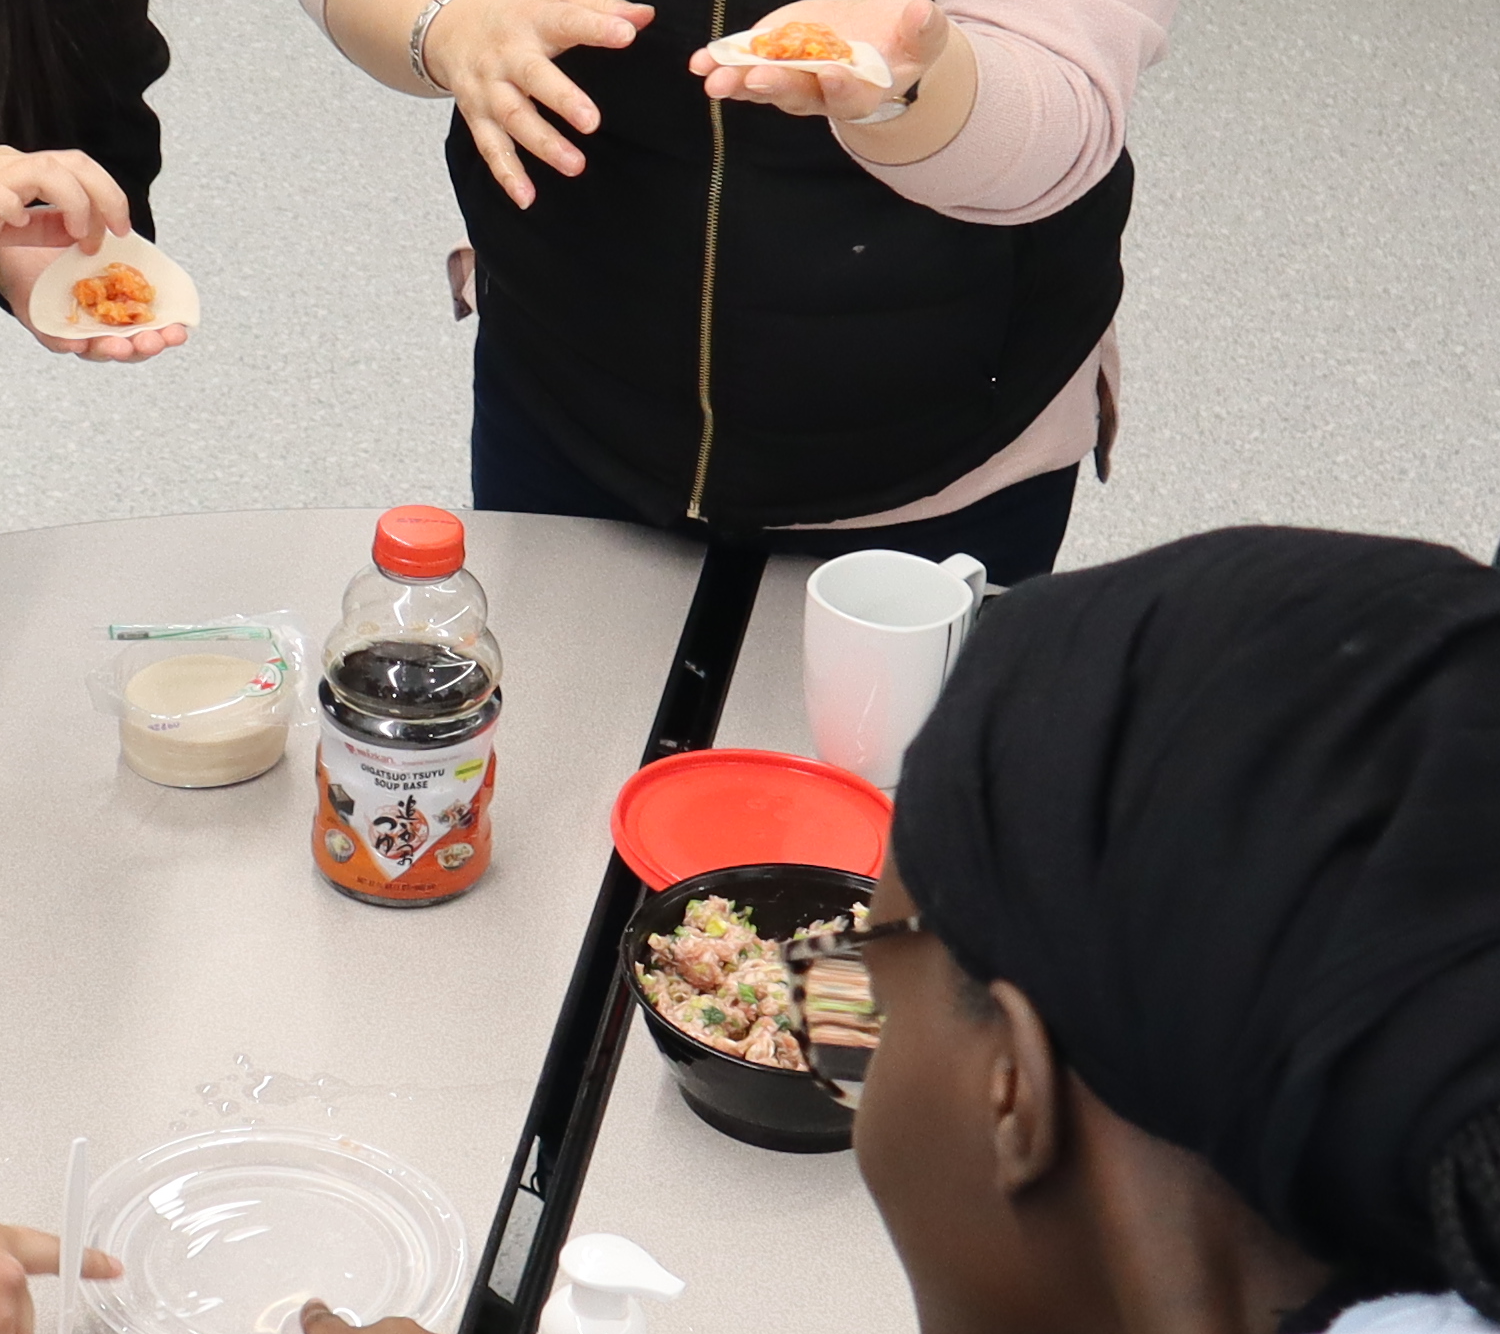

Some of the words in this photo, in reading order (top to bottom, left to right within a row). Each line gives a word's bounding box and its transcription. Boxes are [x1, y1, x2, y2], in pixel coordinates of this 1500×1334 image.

[413, 768, 445, 780] TSUYU
[374, 777, 400, 791] SOUP
[403, 780, 429, 791] BASE
[373, 816, 398, 855] つゆ
